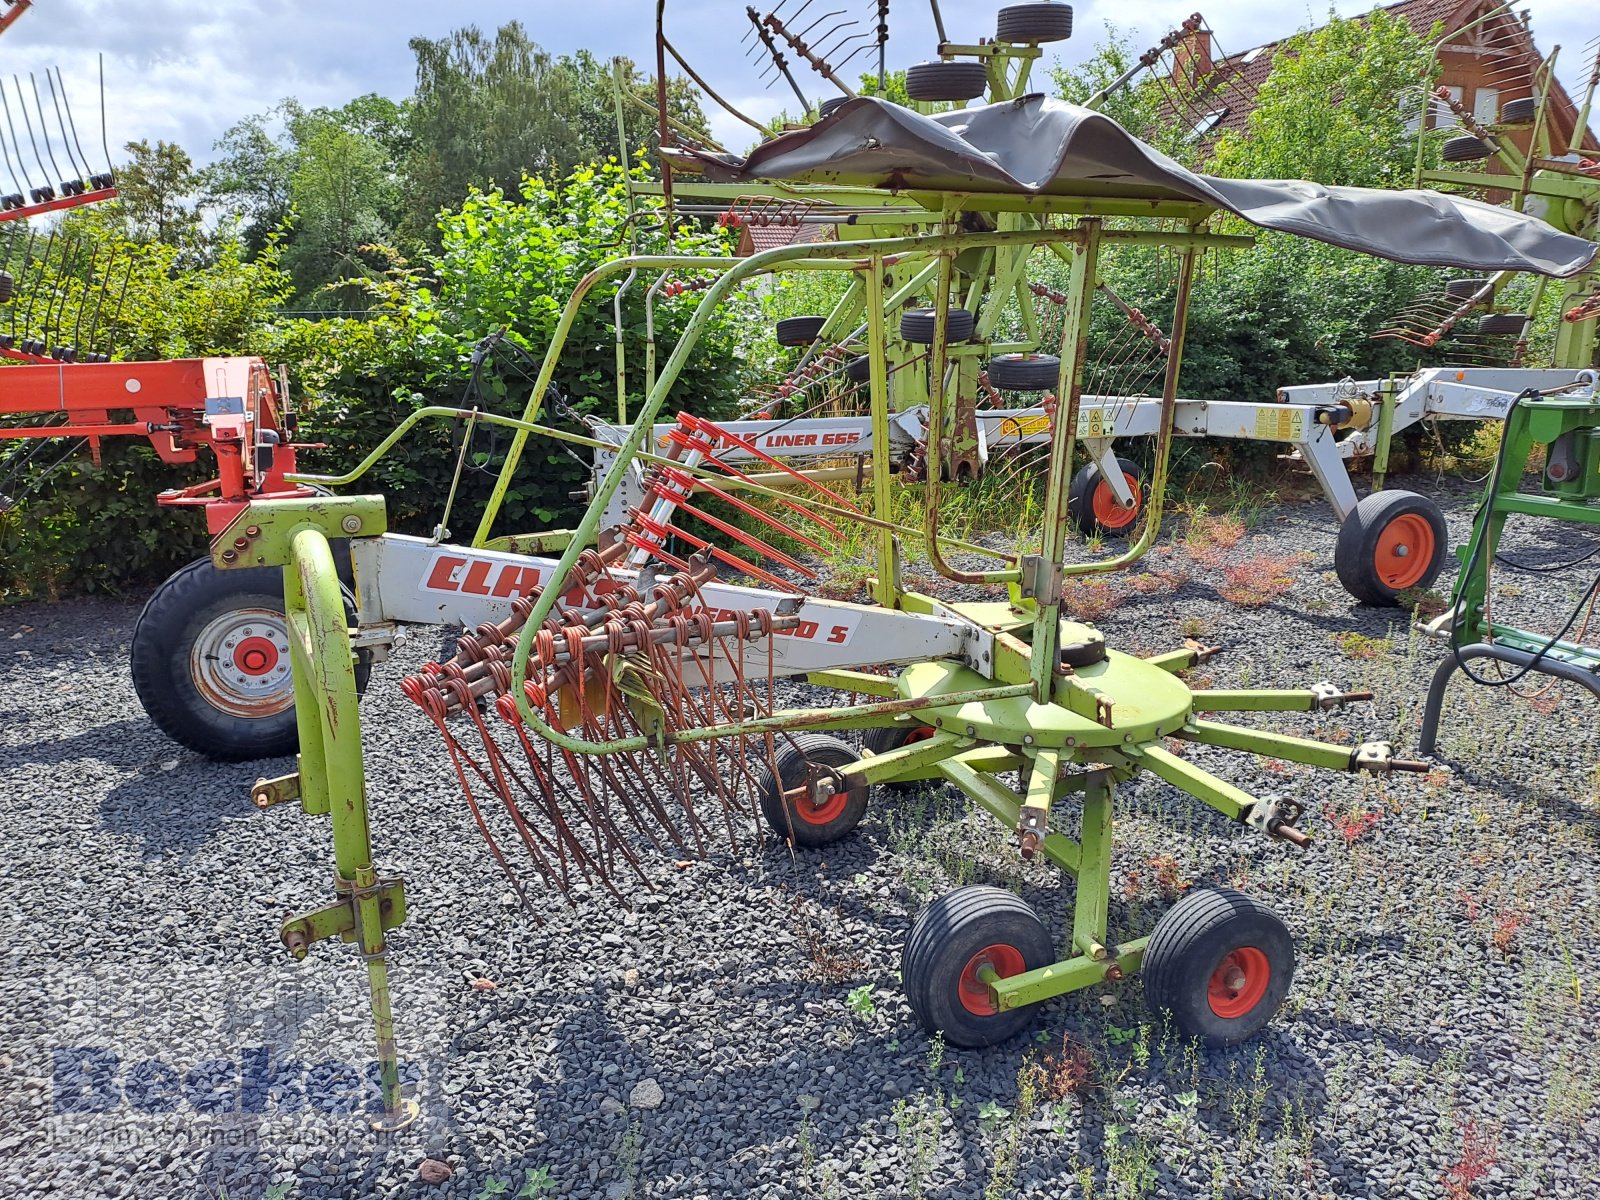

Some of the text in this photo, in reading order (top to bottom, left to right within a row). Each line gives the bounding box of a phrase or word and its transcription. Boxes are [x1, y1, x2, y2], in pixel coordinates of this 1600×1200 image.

[766, 434, 818, 447] LINER
[822, 432, 861, 445] 665
[826, 625, 849, 643] S
